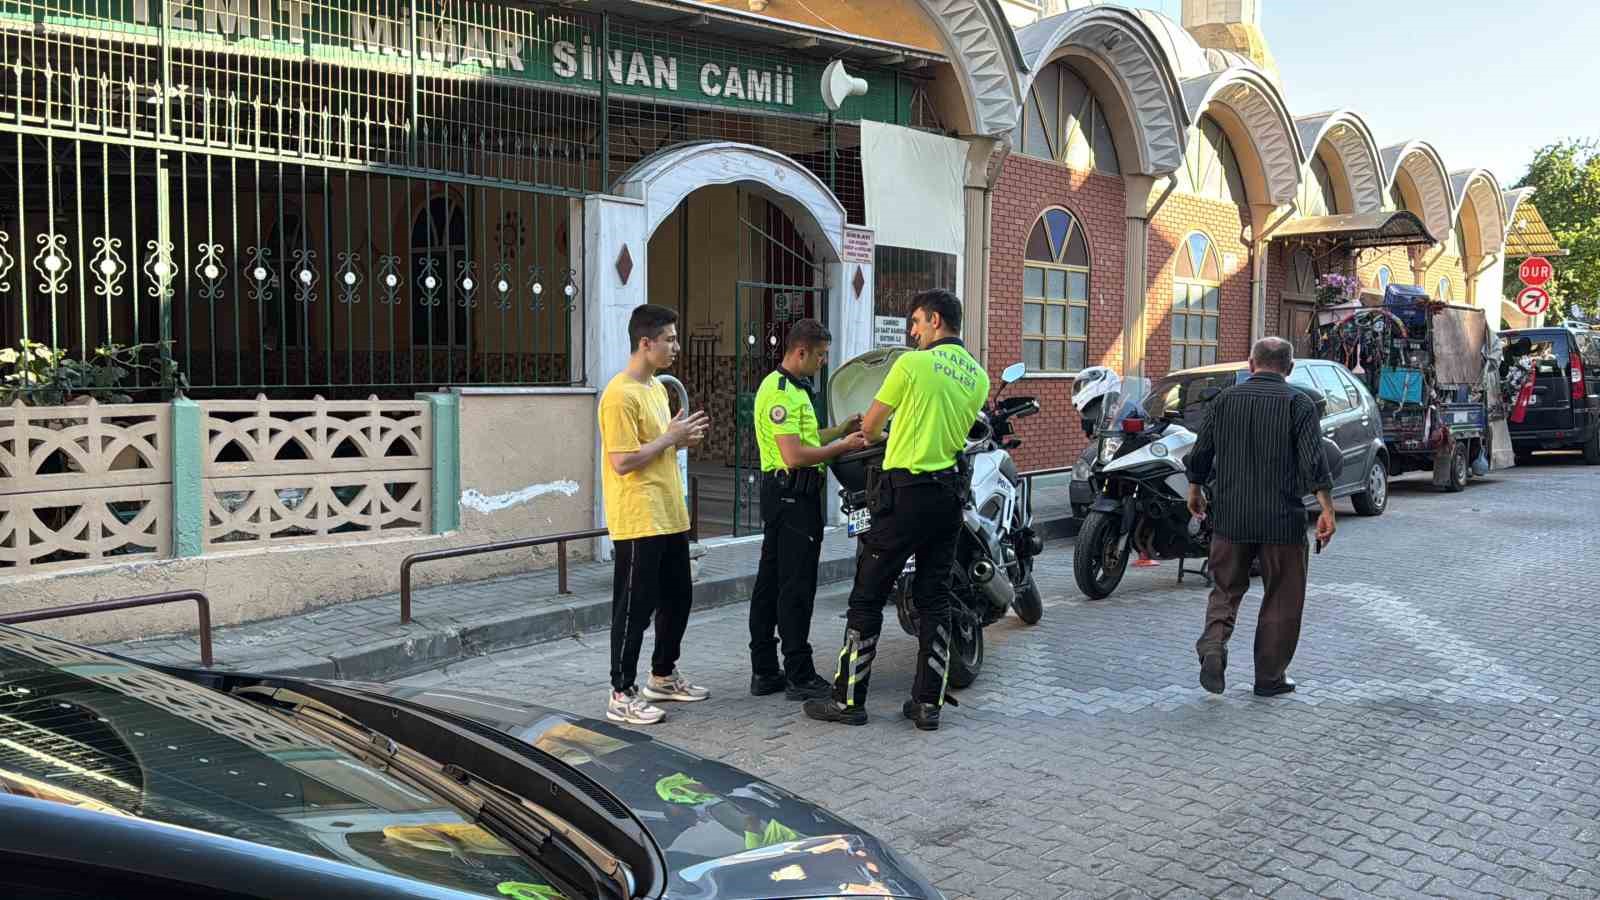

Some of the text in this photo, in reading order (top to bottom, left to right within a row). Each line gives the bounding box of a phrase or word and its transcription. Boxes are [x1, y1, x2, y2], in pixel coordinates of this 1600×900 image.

[351, 7, 525, 71] MİMAR
[552, 36, 678, 90] SİNAN
[699, 62, 794, 105] CAMİİ
[1521, 265, 1549, 278] DUR
